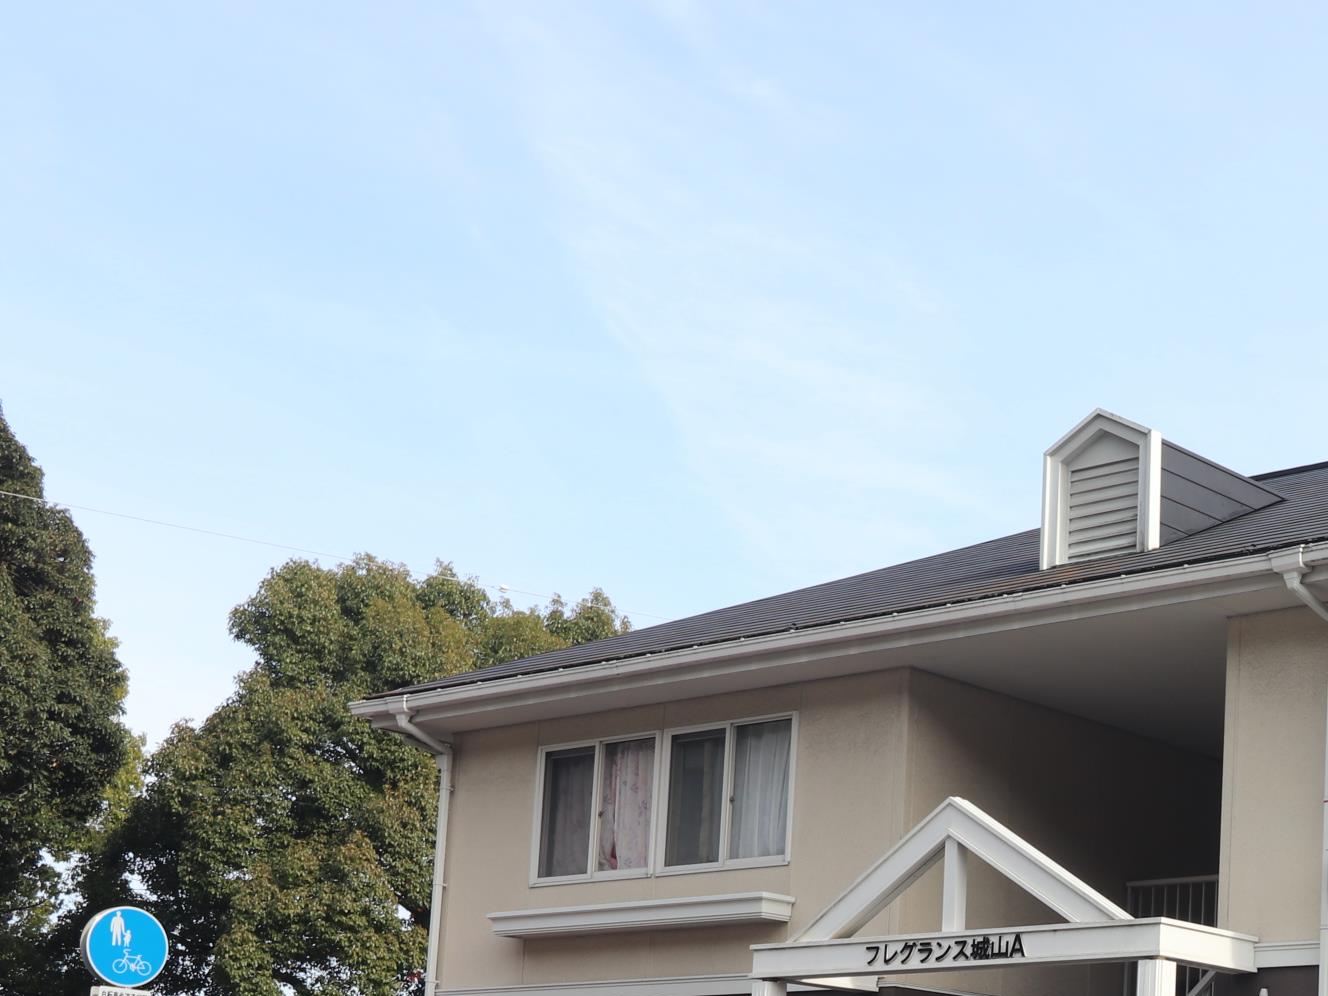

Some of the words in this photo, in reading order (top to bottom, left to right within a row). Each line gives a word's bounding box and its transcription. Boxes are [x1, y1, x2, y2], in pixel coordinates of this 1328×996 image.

[865, 933, 1026, 966] フレグランス城山A
